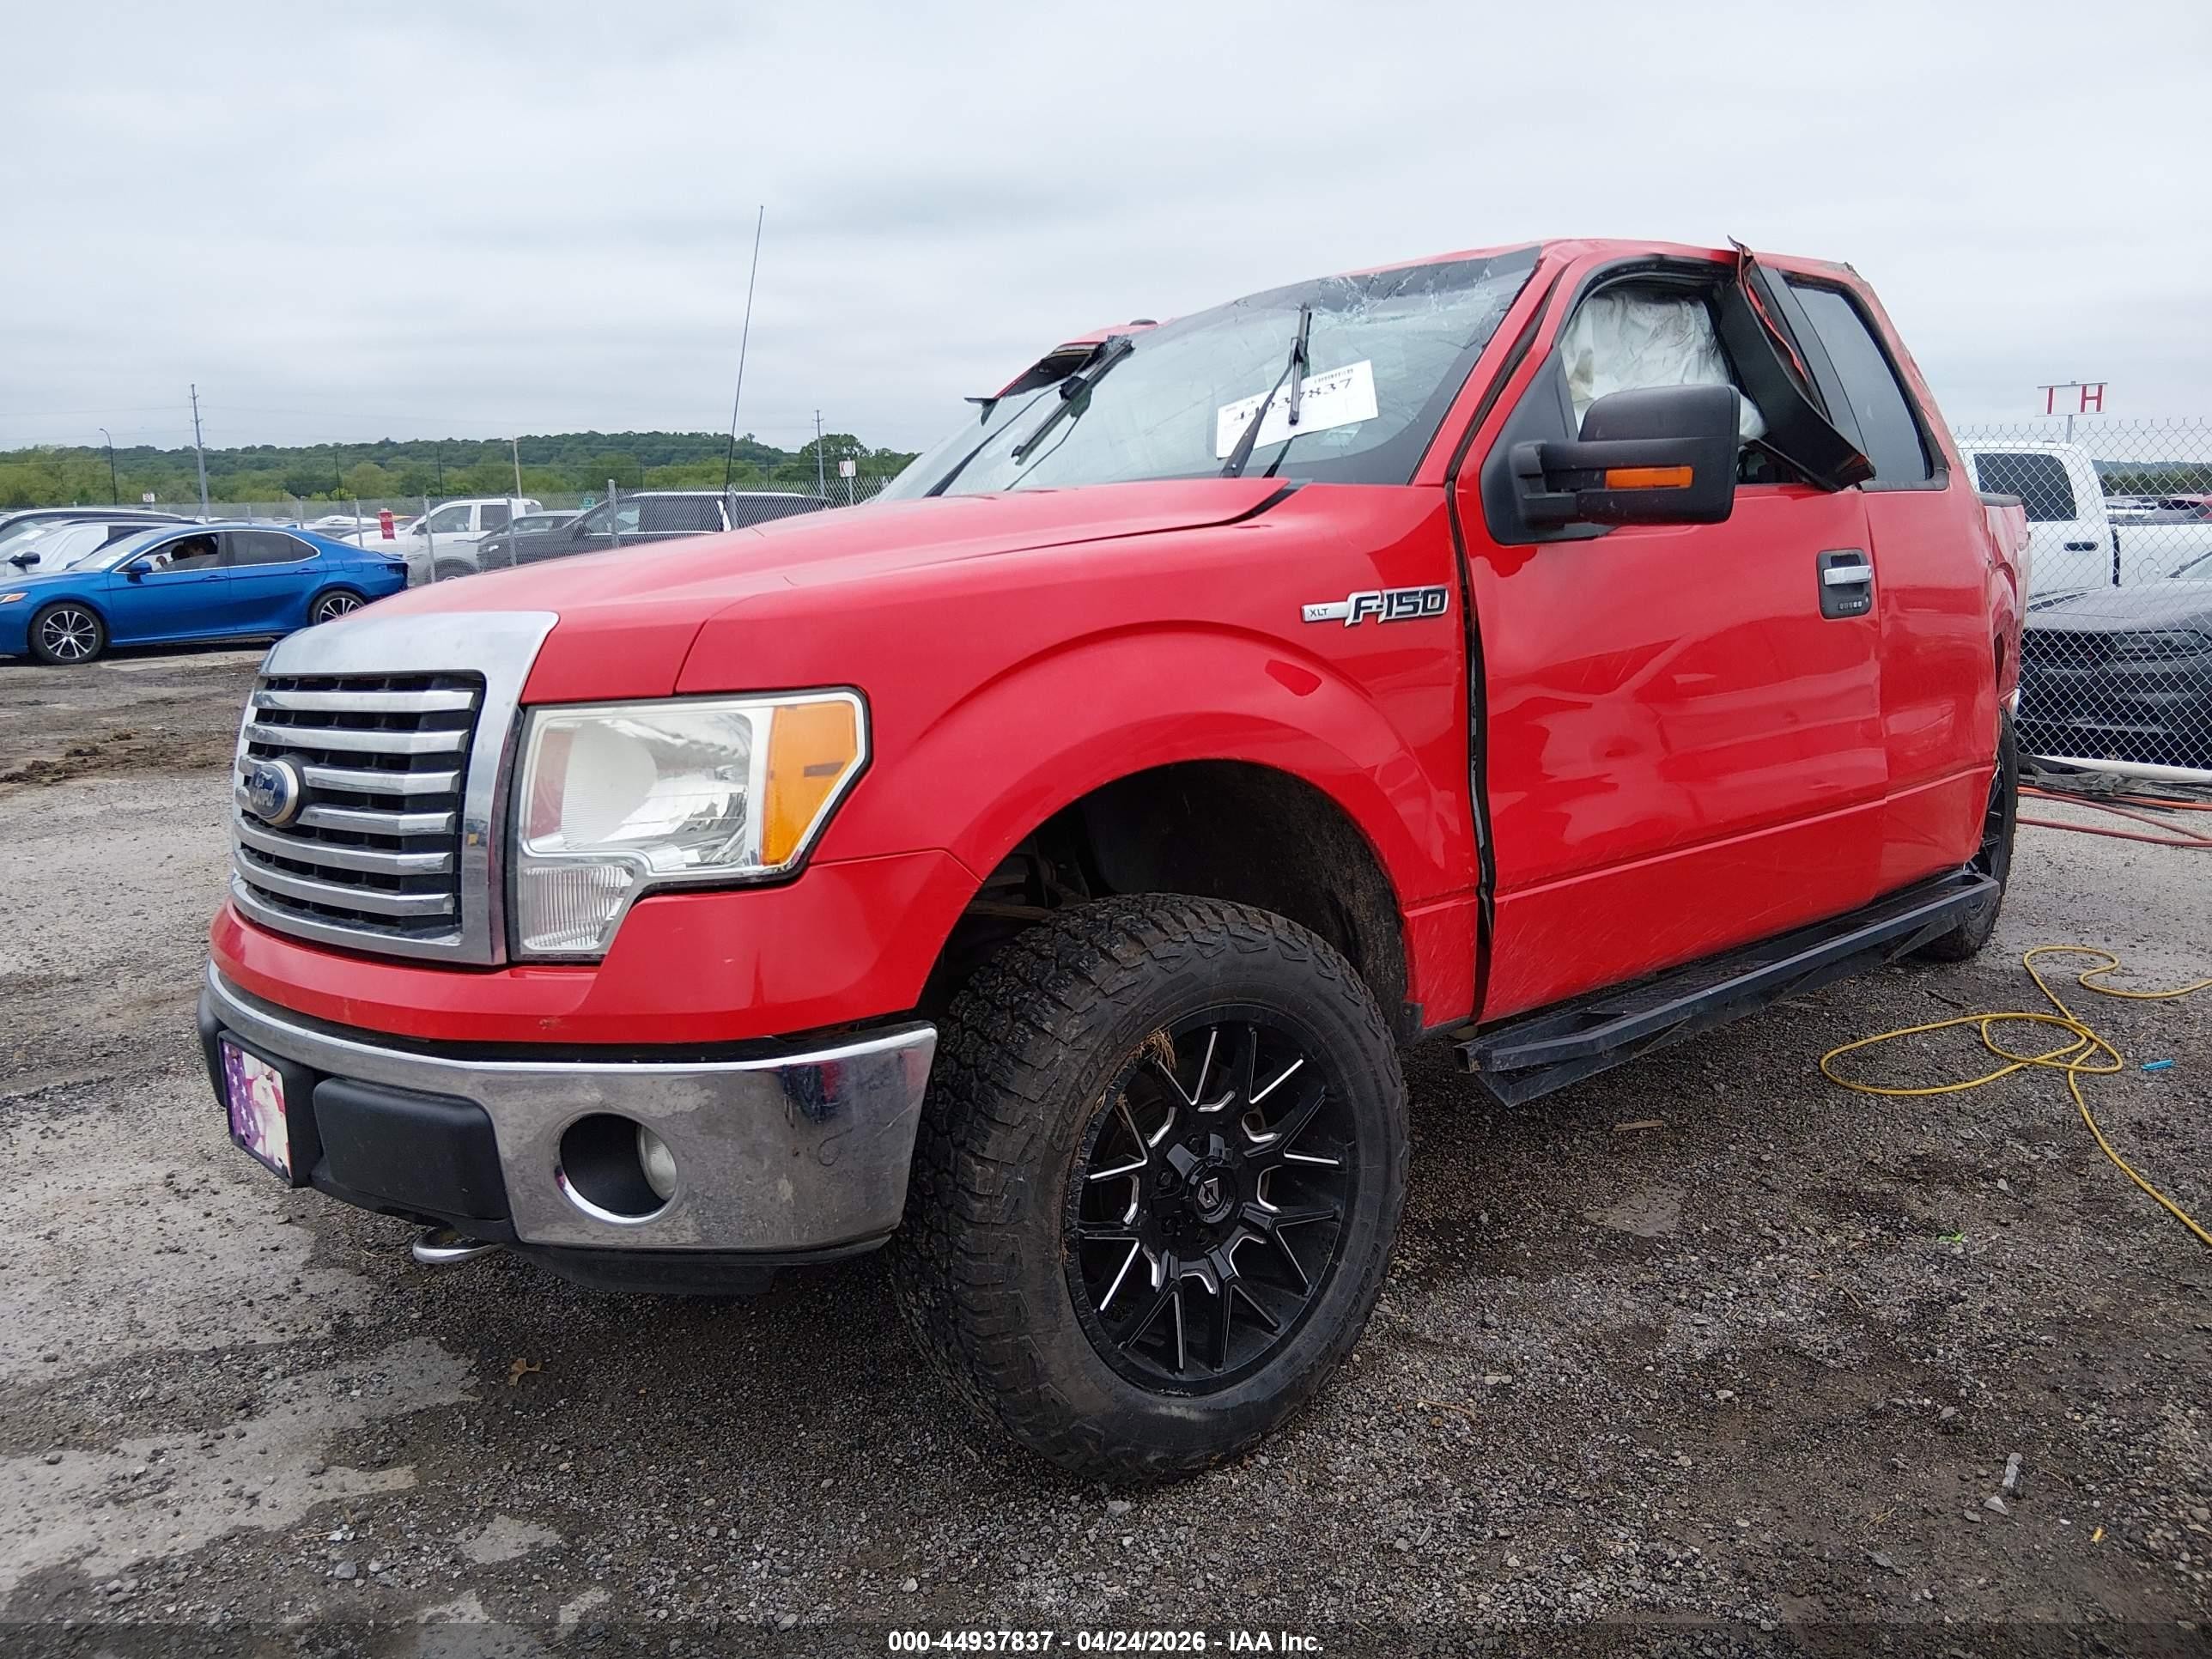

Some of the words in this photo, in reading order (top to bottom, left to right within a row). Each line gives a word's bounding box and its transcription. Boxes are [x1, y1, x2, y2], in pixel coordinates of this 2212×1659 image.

[2080, 384, 2104, 413] H
[1309, 607, 1329, 617] XLT
[1346, 586, 1449, 625] F-150
